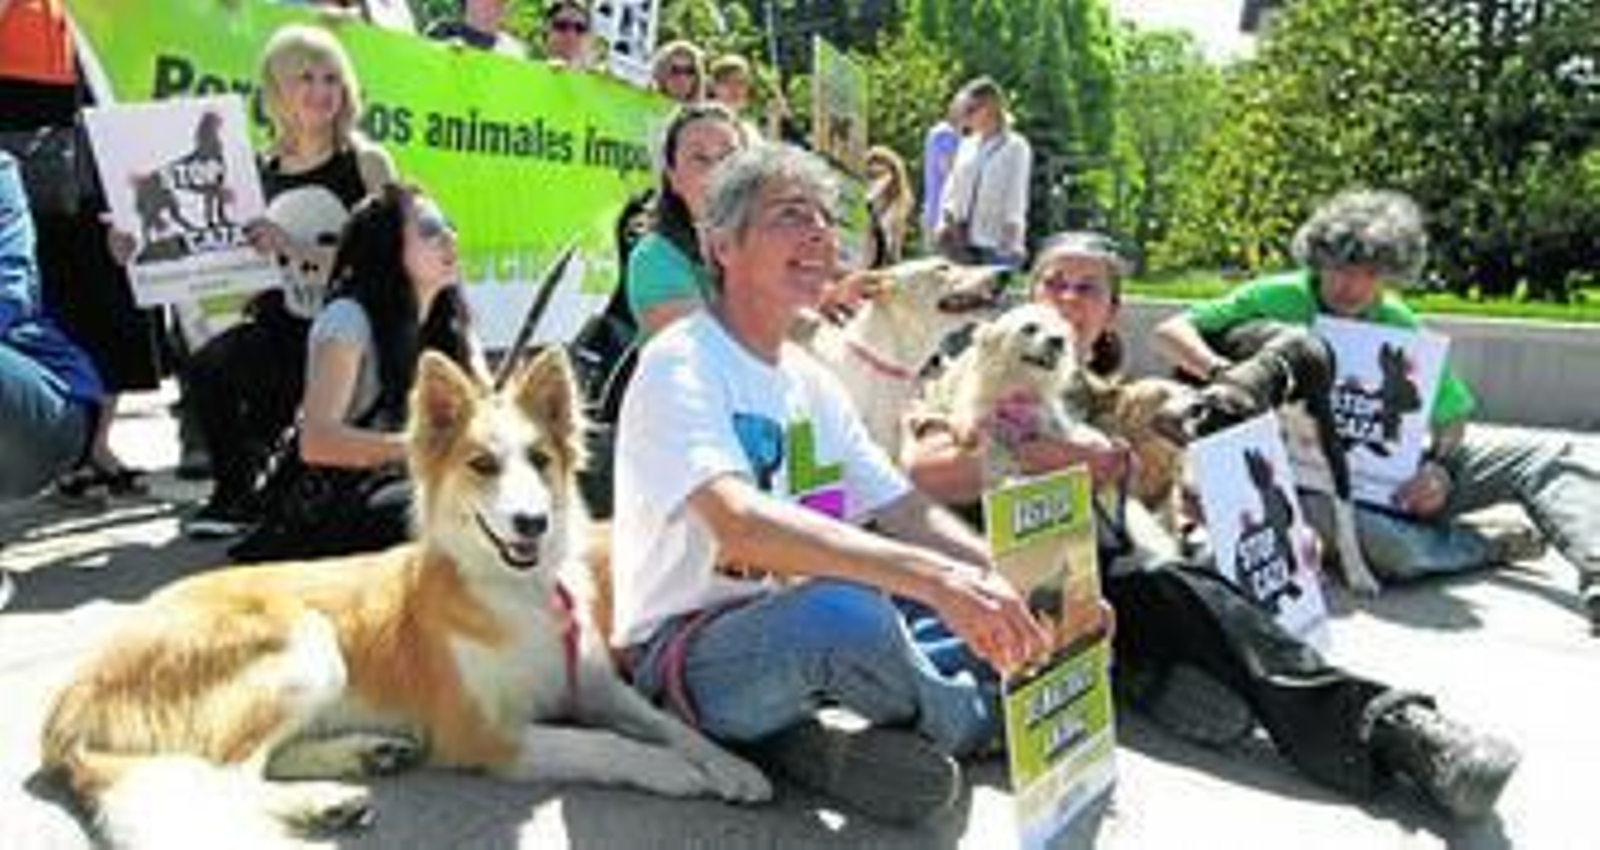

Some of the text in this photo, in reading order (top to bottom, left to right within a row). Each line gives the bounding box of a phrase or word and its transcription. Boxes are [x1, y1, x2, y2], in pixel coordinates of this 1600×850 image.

[358, 102, 413, 146] os
[426, 109, 573, 165] animales
[1330, 388, 1383, 415] STOP
[1335, 413, 1383, 442] CAZA
[1239, 527, 1276, 572] STOP
[1253, 559, 1288, 601] CAZA
